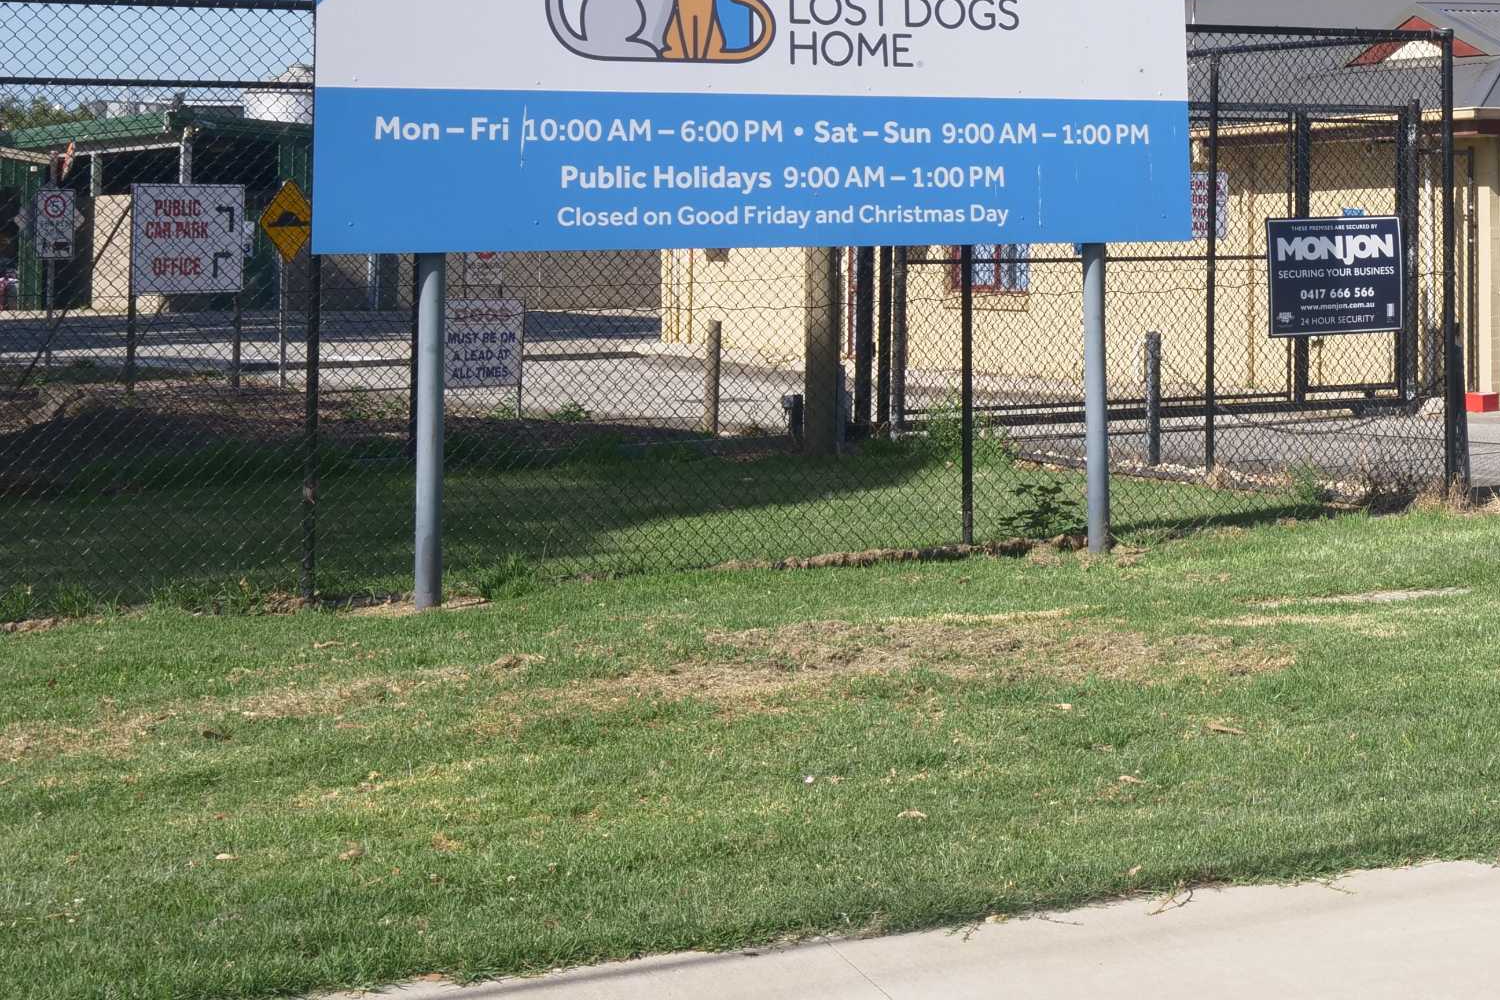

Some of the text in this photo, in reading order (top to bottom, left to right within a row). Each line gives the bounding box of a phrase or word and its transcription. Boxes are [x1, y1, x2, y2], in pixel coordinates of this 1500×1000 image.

[789, 30, 914, 68] HOME
[375, 116, 440, 141] Mon
[471, 117, 509, 141] Fri
[523, 118, 602, 142] 10:00
[607, 118, 651, 142] AM
[680, 120, 739, 143] 6:00
[744, 119, 783, 142] PM
[814, 120, 858, 143] Sat
[883, 120, 931, 144] Sun
[942, 123, 995, 145] 9:00
[999, 122, 1037, 144] AM
[1062, 124, 1112, 145] 1:00
[1116, 123, 1149, 145] PM
[561, 165, 647, 189] Public
[653, 165, 772, 195] Holidays
[783, 166, 840, 189] 9:00
[844, 166, 885, 188] AM
[912, 166, 964, 188] 1:00
[969, 166, 1005, 187] PM
[154, 199, 202, 217] PUBLIC
[557, 204, 1009, 229] Closed on Good Friday and Christmas Day
[145, 221, 209, 239] CAR PARK
[1276, 233, 1395, 266] MONJON
[152, 256, 202, 276] OFFICE
[1278, 266, 1395, 279] SECURING YOUR BUSINESS
[1300, 286, 1375, 300] 0417 666 566
[1300, 301, 1375, 311] www.monjon.com.au
[1300, 317, 1310, 326] 24
[1311, 316, 1336, 326] HOUR
[1337, 314, 1375, 325] SECURITY
[447, 332, 516, 345] MUST BE ON
[464, 349, 494, 362] LEAD
[498, 348, 511, 361] AT
[452, 366, 509, 379] ALL TIMES
